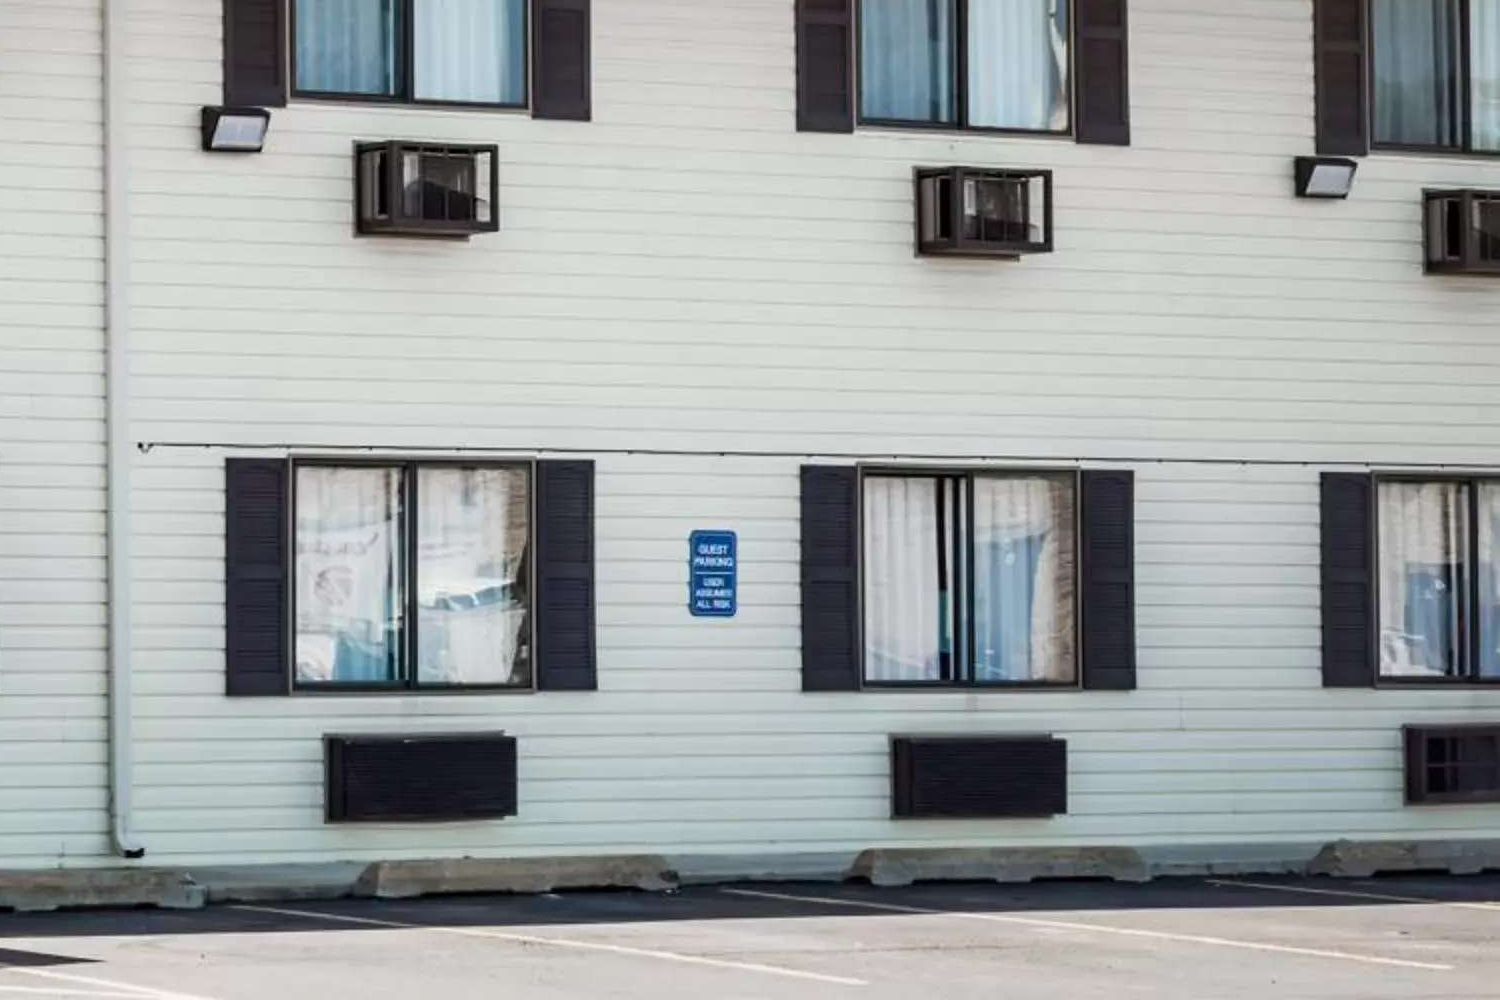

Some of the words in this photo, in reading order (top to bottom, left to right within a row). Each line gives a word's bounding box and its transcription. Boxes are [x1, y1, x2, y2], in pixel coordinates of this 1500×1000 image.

[697, 543, 729, 554] GUEST
[693, 557, 733, 567] PARKING
[703, 577, 725, 587] USER
[696, 599, 712, 609] ALL
[714, 599, 731, 609] RISK
